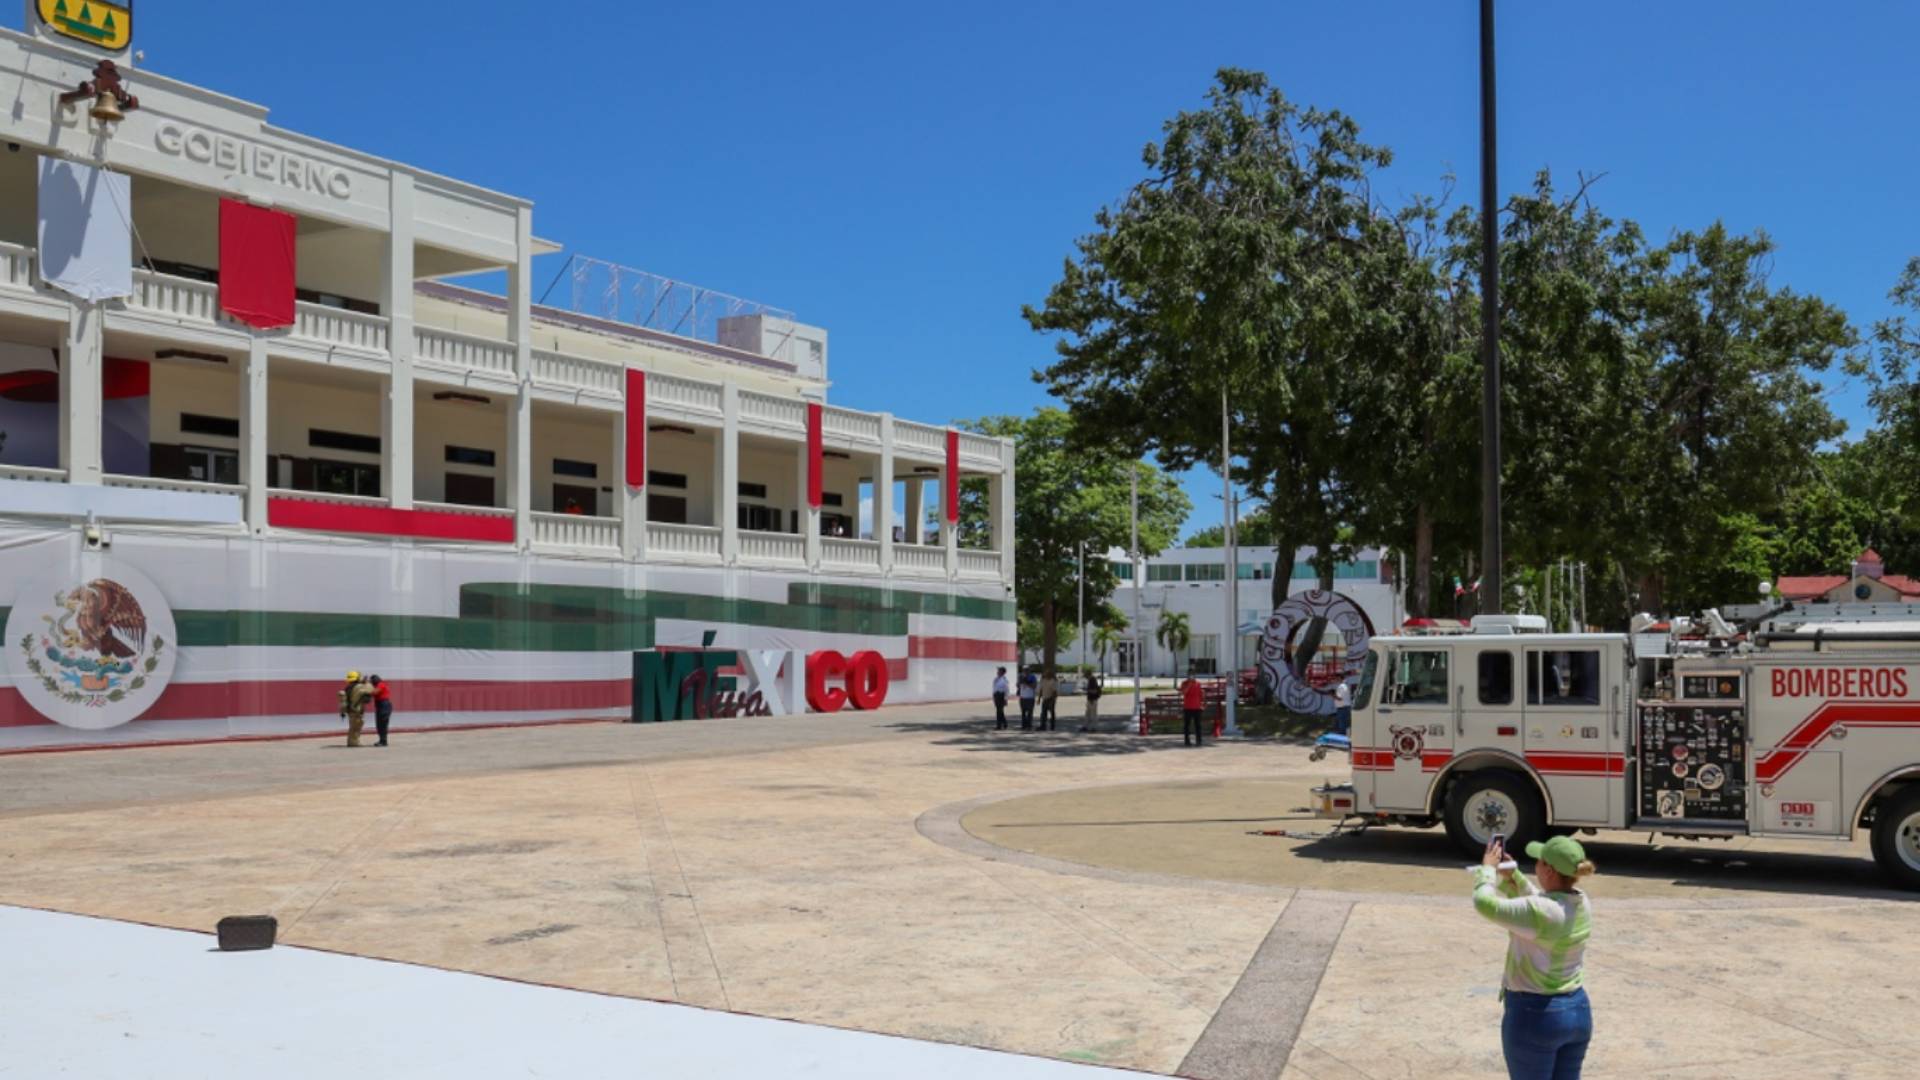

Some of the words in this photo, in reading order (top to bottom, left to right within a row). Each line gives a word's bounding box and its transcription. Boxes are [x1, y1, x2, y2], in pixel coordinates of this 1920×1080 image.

[154, 119, 351, 200] GOBIERNO
[632, 630, 889, 722] MÉXICO
[1771, 667, 1909, 698] BOMBEROS
